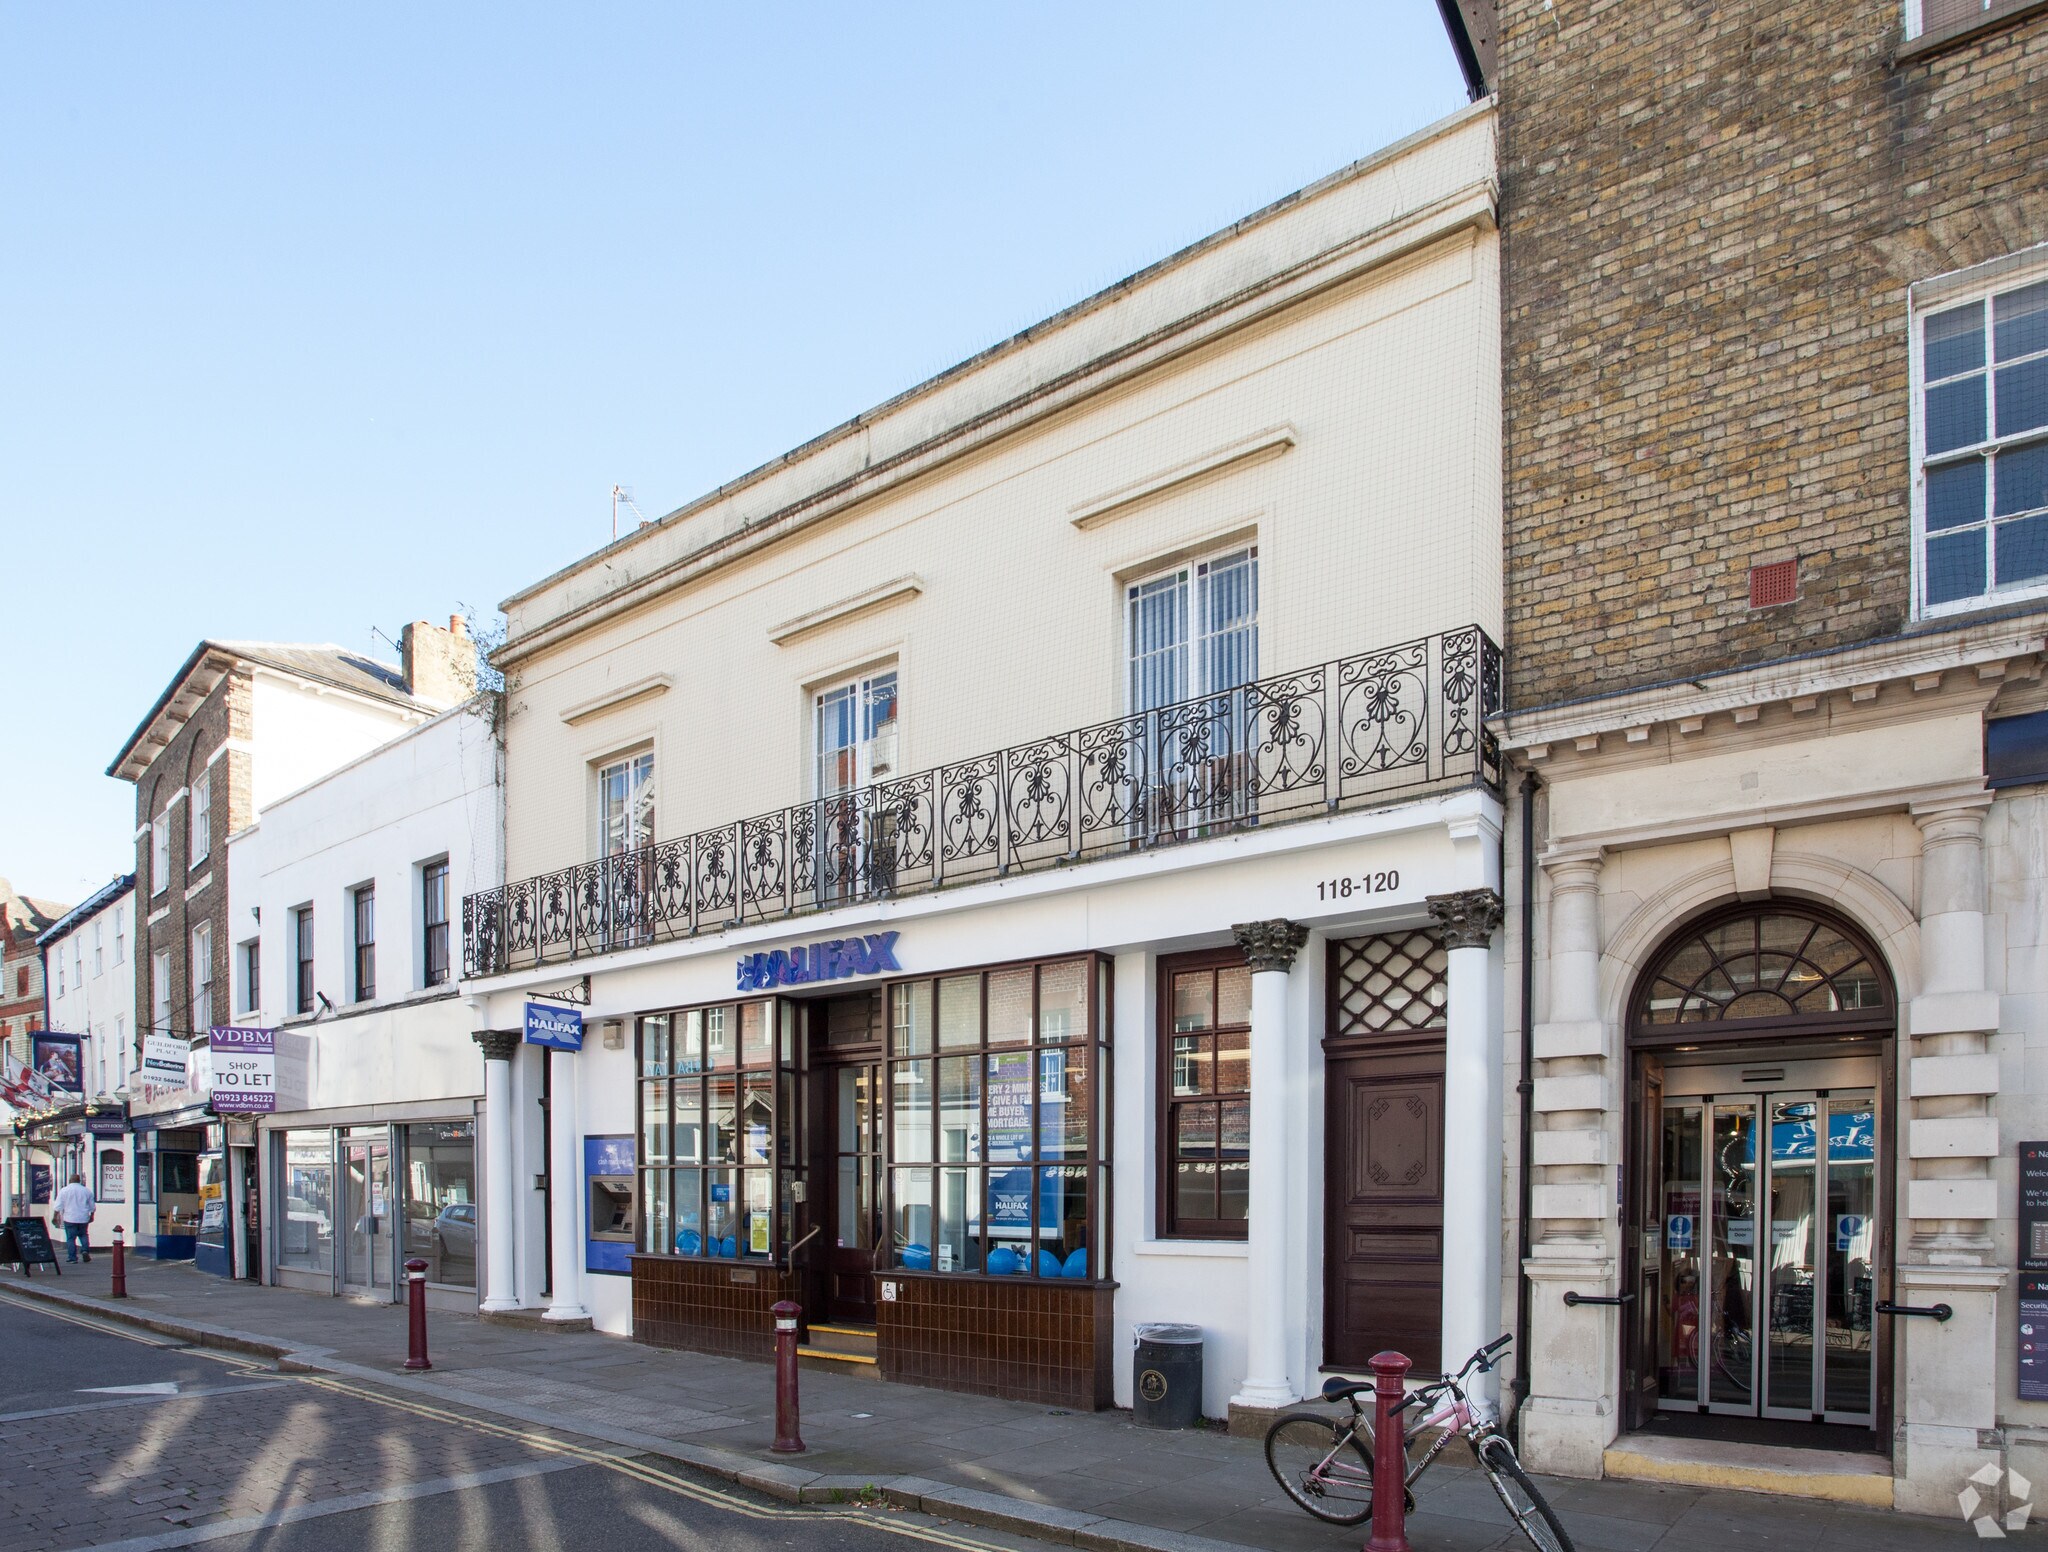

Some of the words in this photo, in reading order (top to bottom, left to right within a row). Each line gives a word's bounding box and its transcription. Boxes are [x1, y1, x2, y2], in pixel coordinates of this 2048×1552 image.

[1317, 870, 1400, 901] 118-120
[737, 931, 903, 992] HALIFAX
[529, 1018, 580, 1035] HALIFAX
[212, 1030, 273, 1043] VDBM
[147, 1040, 188, 1051] GUILDFORD
[156, 1048, 177, 1056] PLACE
[229, 1062, 258, 1070] SHOP
[216, 1073, 239, 1085] TO
[244, 1074, 272, 1086] LET
[1005, 1084, 1011, 1095] 2
[214, 1093, 241, 1102] 01923
[242, 1094, 274, 1103] 845222
[992, 1094, 1011, 1106] GIVE
[1012, 1094, 1018, 1105] A
[999, 1106, 1025, 1117] BUYER
[995, 1202, 1028, 1210] HALIFAX
[2025, 1260, 2048, 1268] Helpful
[1418, 1428, 1452, 1469] OPTIMA
